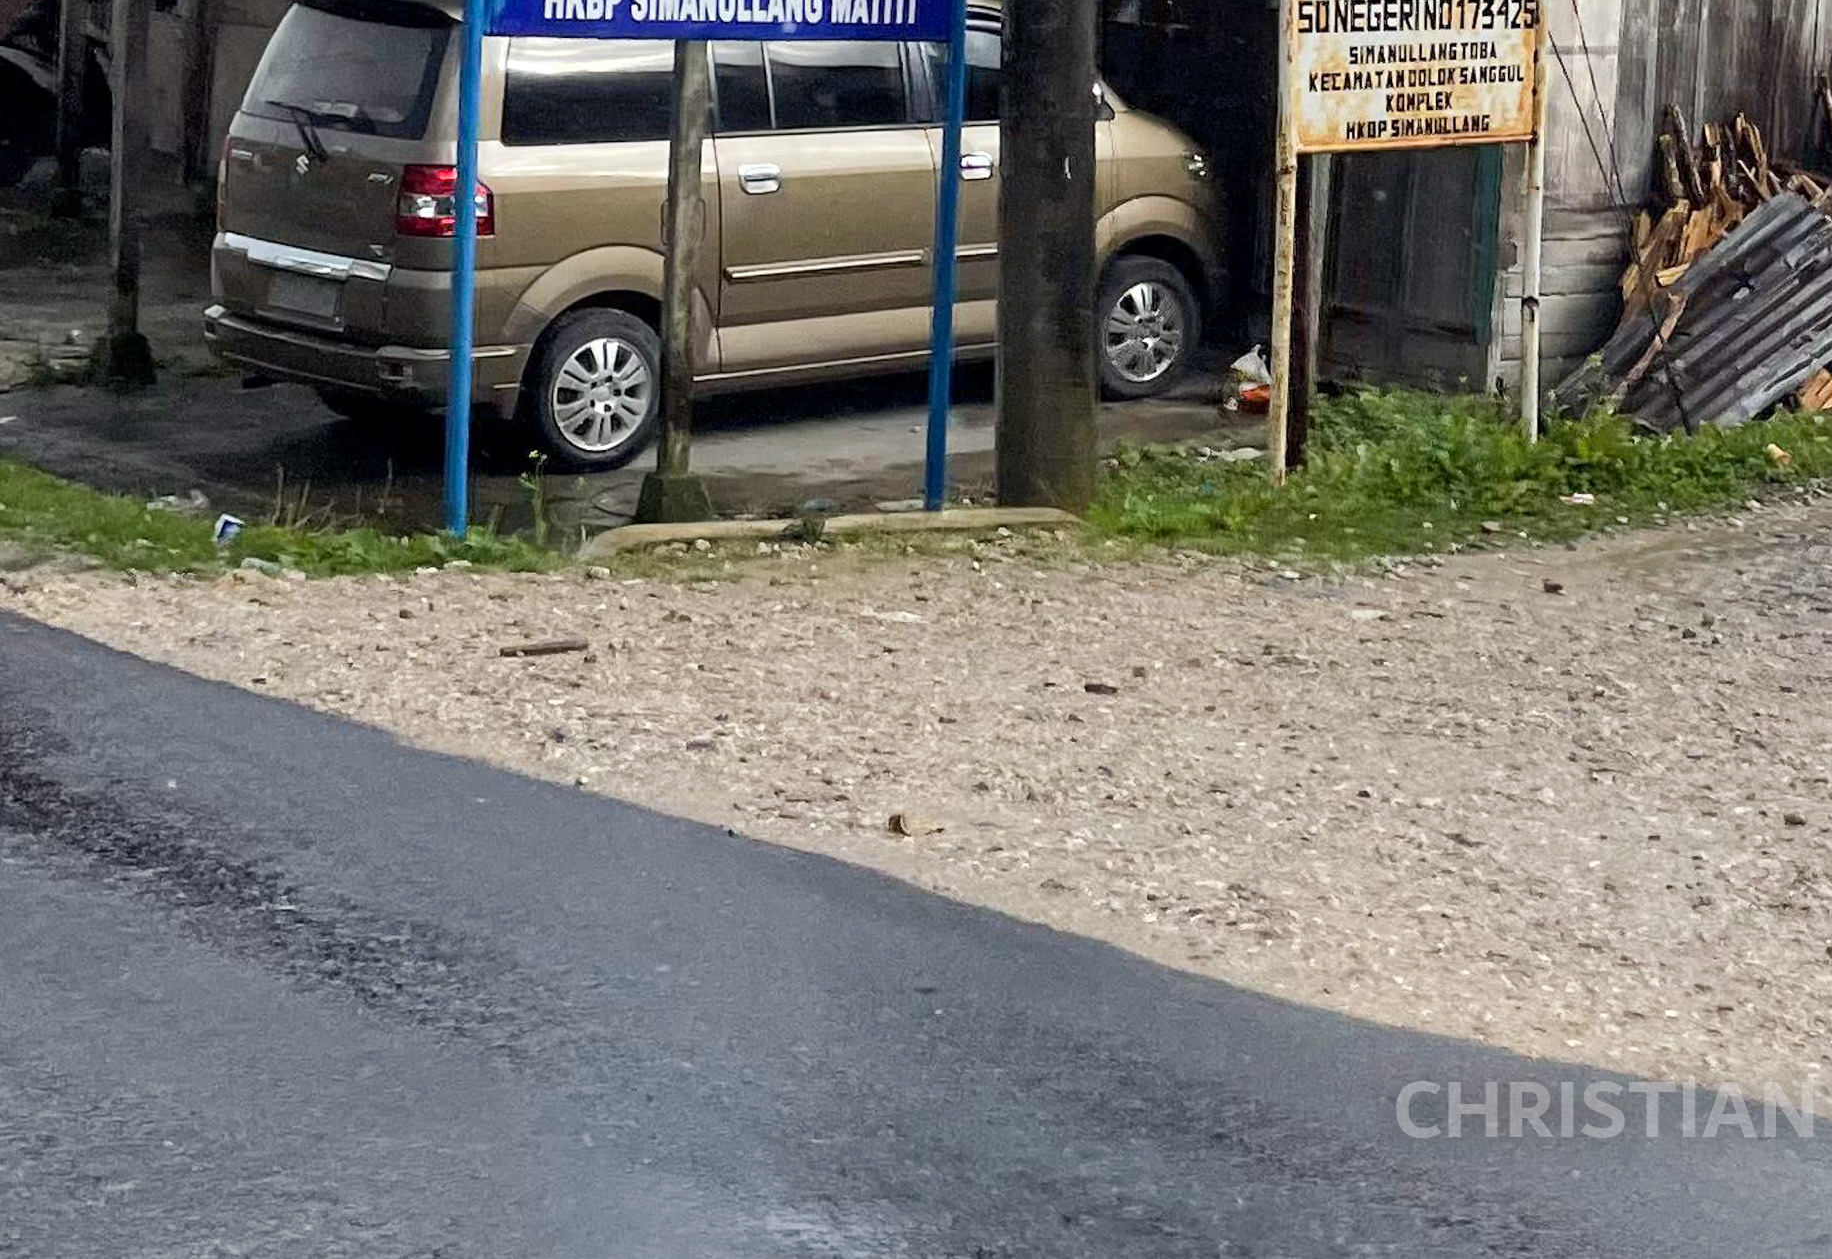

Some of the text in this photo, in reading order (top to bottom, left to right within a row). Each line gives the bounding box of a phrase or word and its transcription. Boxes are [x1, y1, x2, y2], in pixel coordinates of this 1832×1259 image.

[1349, 42, 1498, 65] SIMANULLANG TOBA
[1309, 65, 1525, 93] KECAMATAN DOLOK SANGGUL
[1391, 115, 1491, 137] SIMANULLANG
